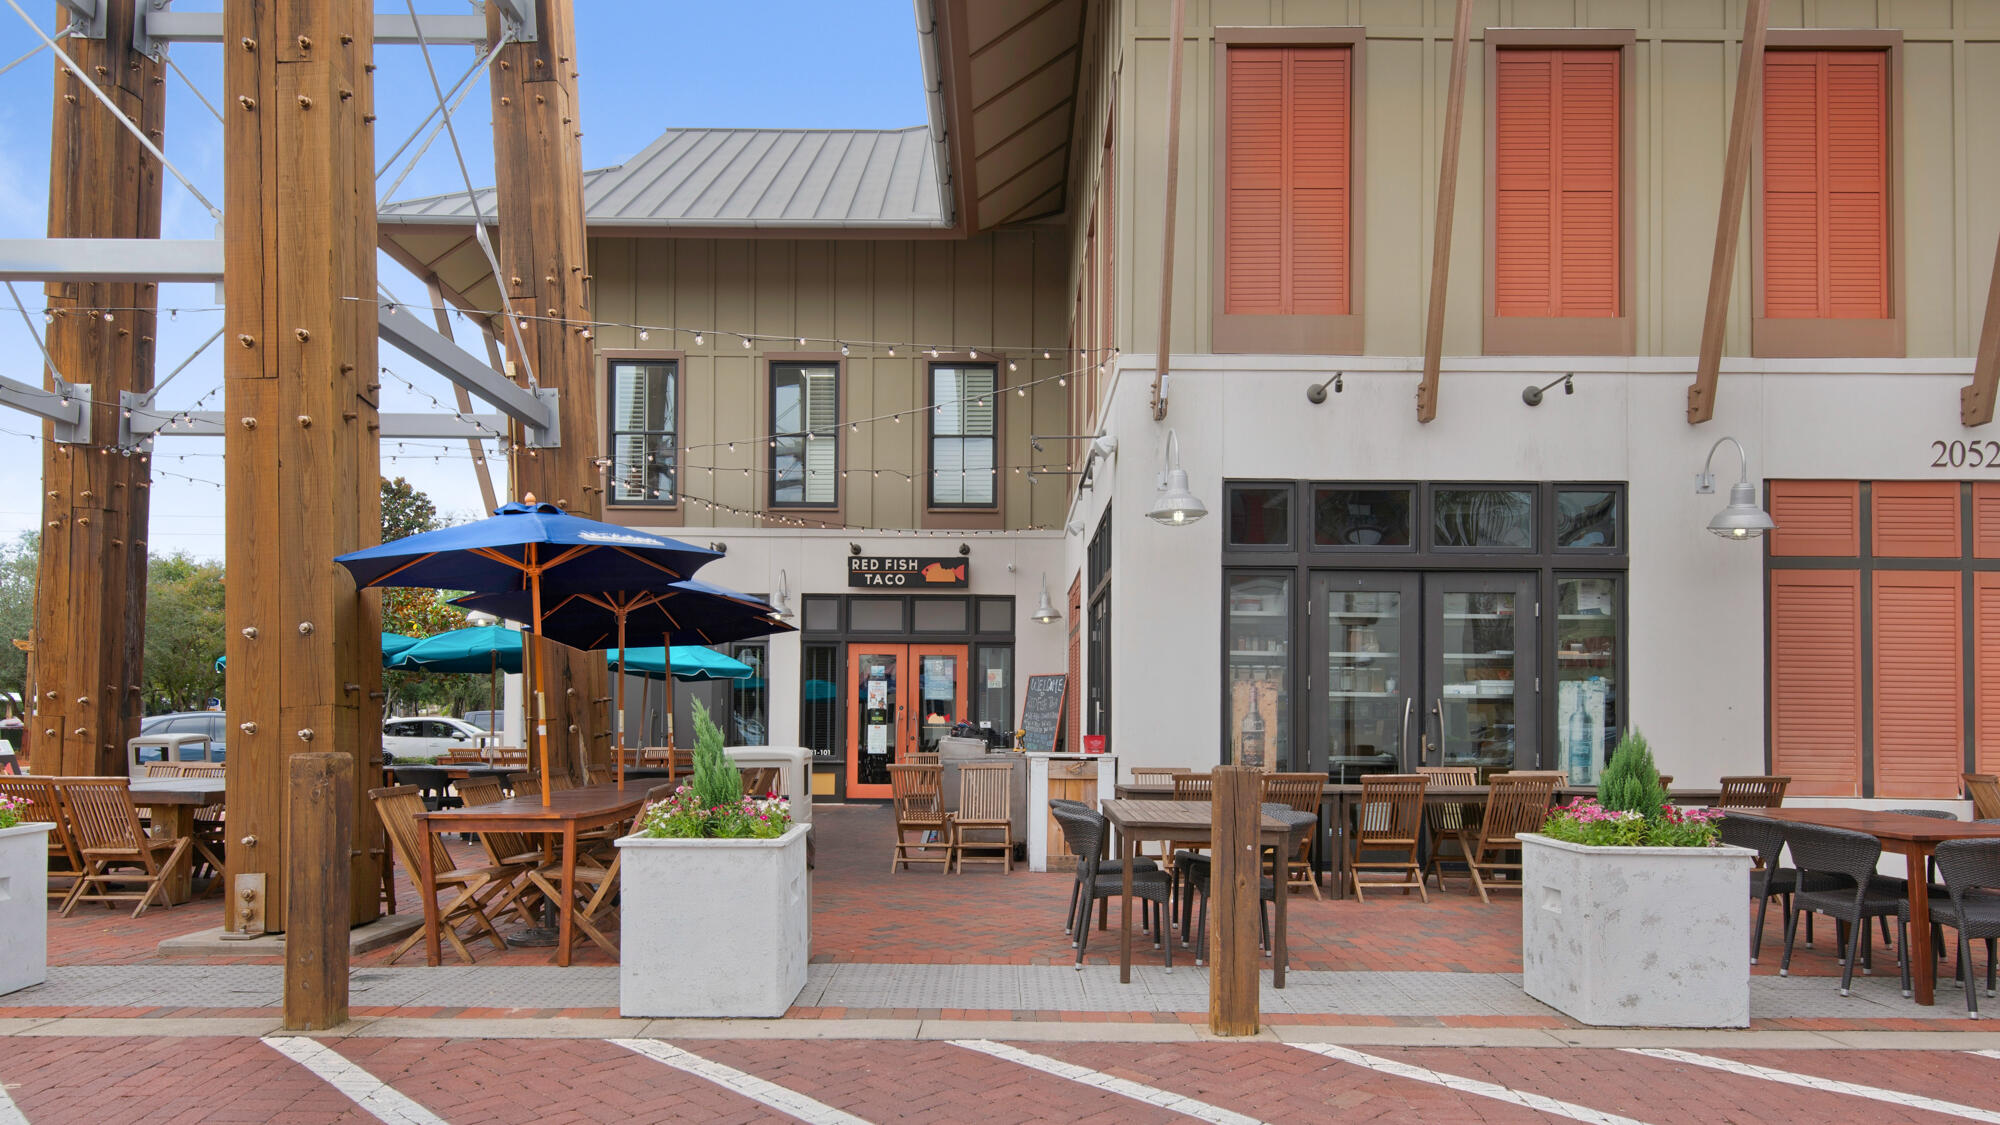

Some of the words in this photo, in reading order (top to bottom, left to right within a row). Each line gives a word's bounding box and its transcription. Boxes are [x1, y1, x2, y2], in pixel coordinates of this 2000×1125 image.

[1931, 440, 2000, 468] 2052
[852, 559, 879, 570] RED
[885, 559, 918, 570] FISH
[865, 574, 905, 585] TACO
